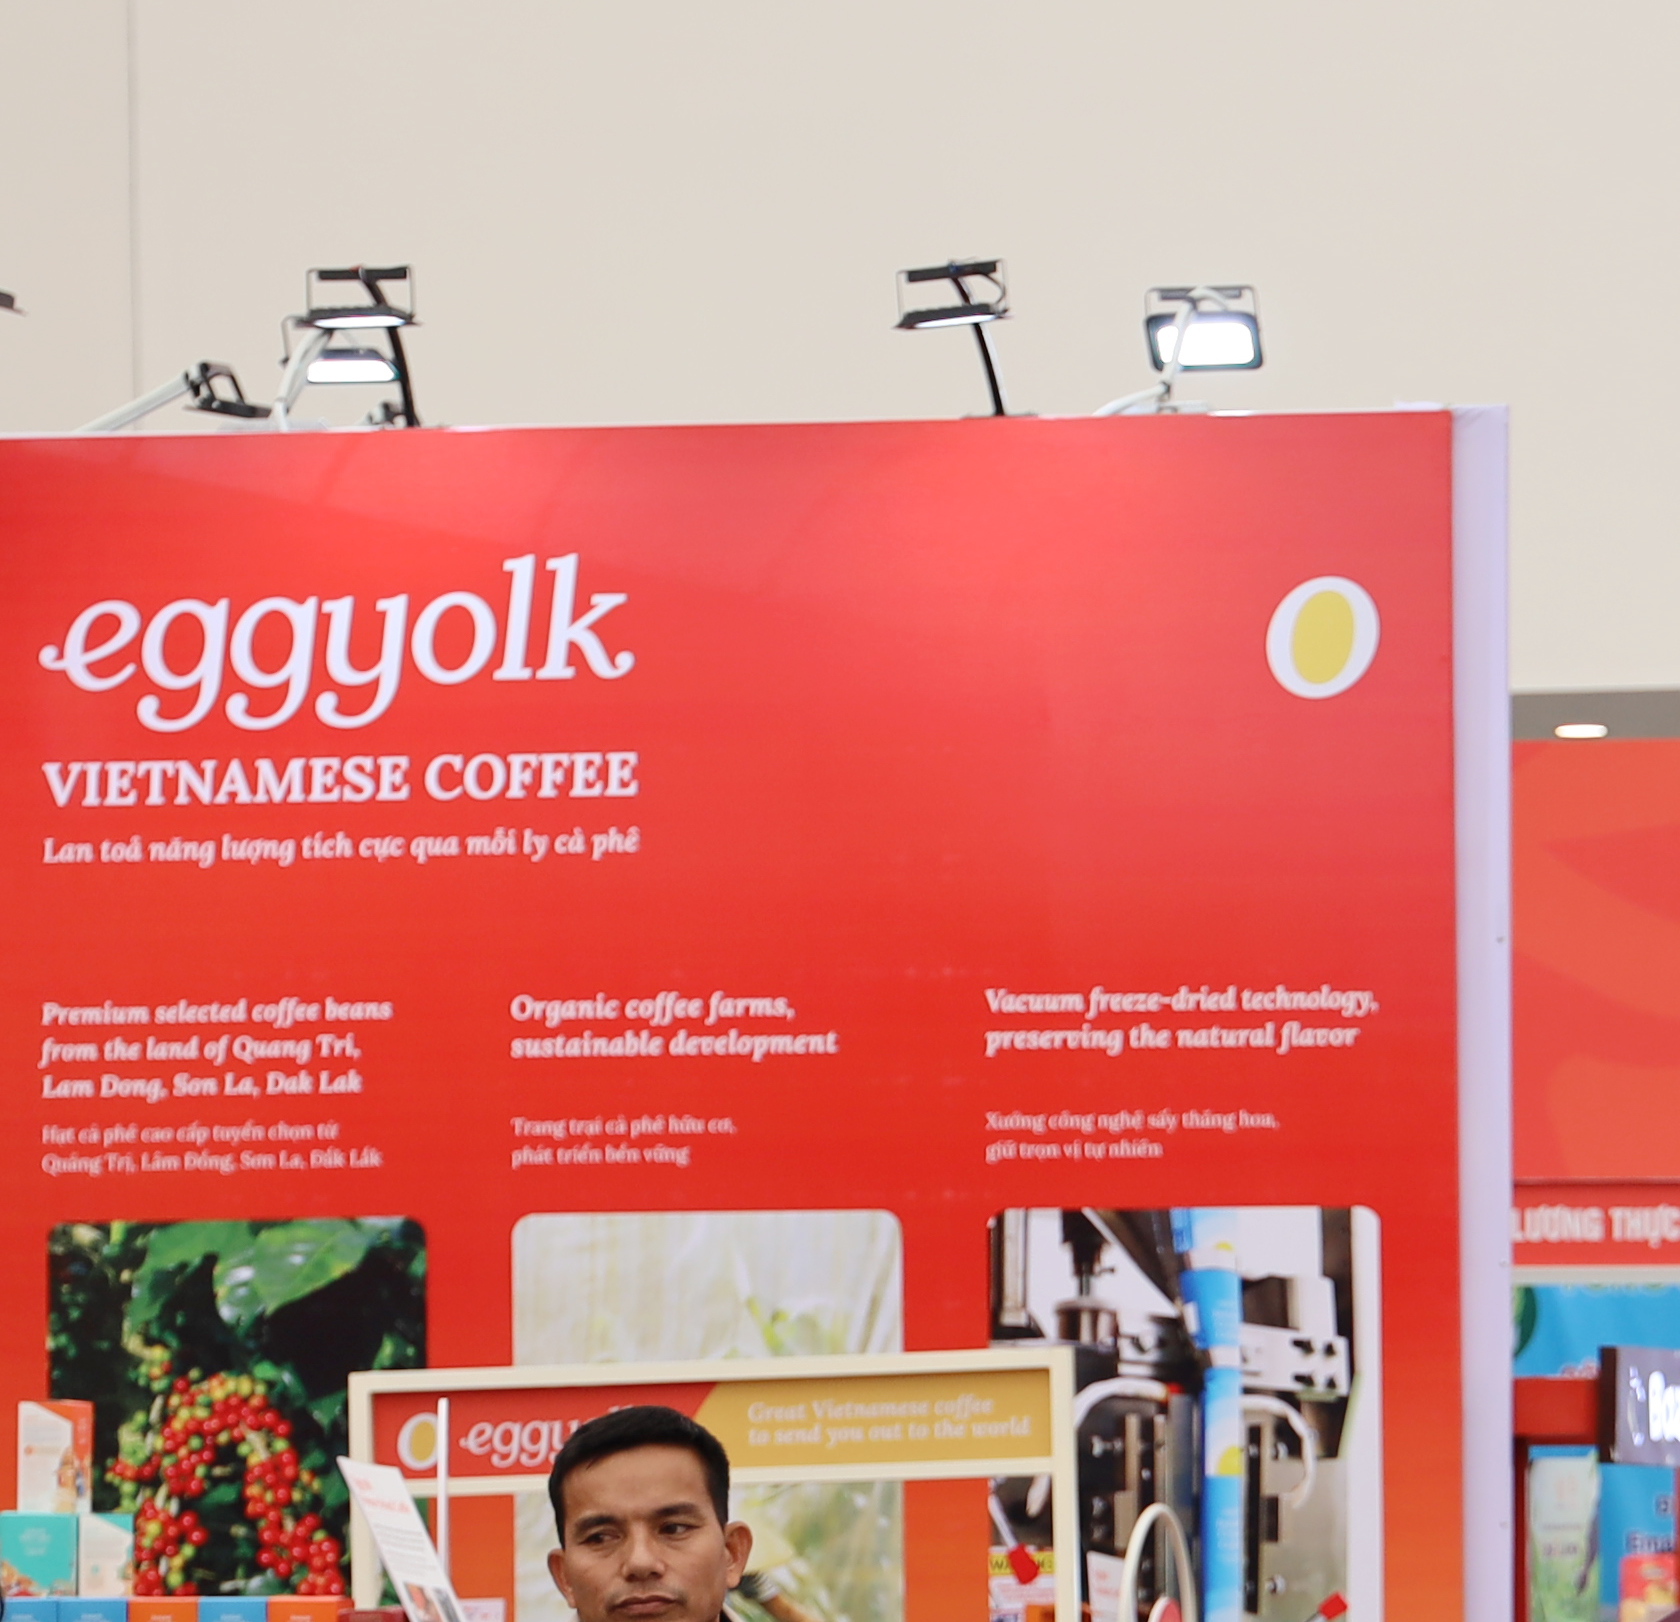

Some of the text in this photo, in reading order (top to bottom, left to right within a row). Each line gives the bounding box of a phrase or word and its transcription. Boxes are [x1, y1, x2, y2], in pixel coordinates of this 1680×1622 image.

[38, 553, 635, 732] eggyolk
[42, 751, 639, 807] VIETNAMESE COFFEE
[43, 836, 93, 864] Lan
[149, 834, 215, 868] năng
[221, 831, 294, 867] lượng
[301, 829, 353, 860] tích
[358, 832, 405, 863] cực
[409, 834, 461, 865] qua
[466, 824, 517, 856] mỗi
[522, 827, 549, 861] ly
[554, 827, 586, 855] cà
[591, 826, 641, 861] phê
[40, 996, 393, 1028] Premium selected coffee beans
[509, 991, 796, 1029] Organic coffee farms,
[984, 984, 1379, 1020] Vacuum freeze-dried technology,
[37, 1037, 99, 1070] from
[103, 1036, 143, 1062] the
[146, 1034, 201, 1061] land
[203, 1034, 231, 1066] of
[232, 1034, 314, 1066] Quang
[509, 1027, 839, 1063] sustainable development
[984, 1021, 1361, 1058] preserving the natural flavor
[41, 1074, 96, 1099] Lam
[172, 1072, 219, 1098] Son
[223, 1071, 261, 1099] La,
[265, 1070, 314, 1096] Dak
[318, 1069, 363, 1096] Lak
[748, 1394, 993, 1423] Great Vietnamese coffee
[749, 1416, 1031, 1448] to send you out to the world
